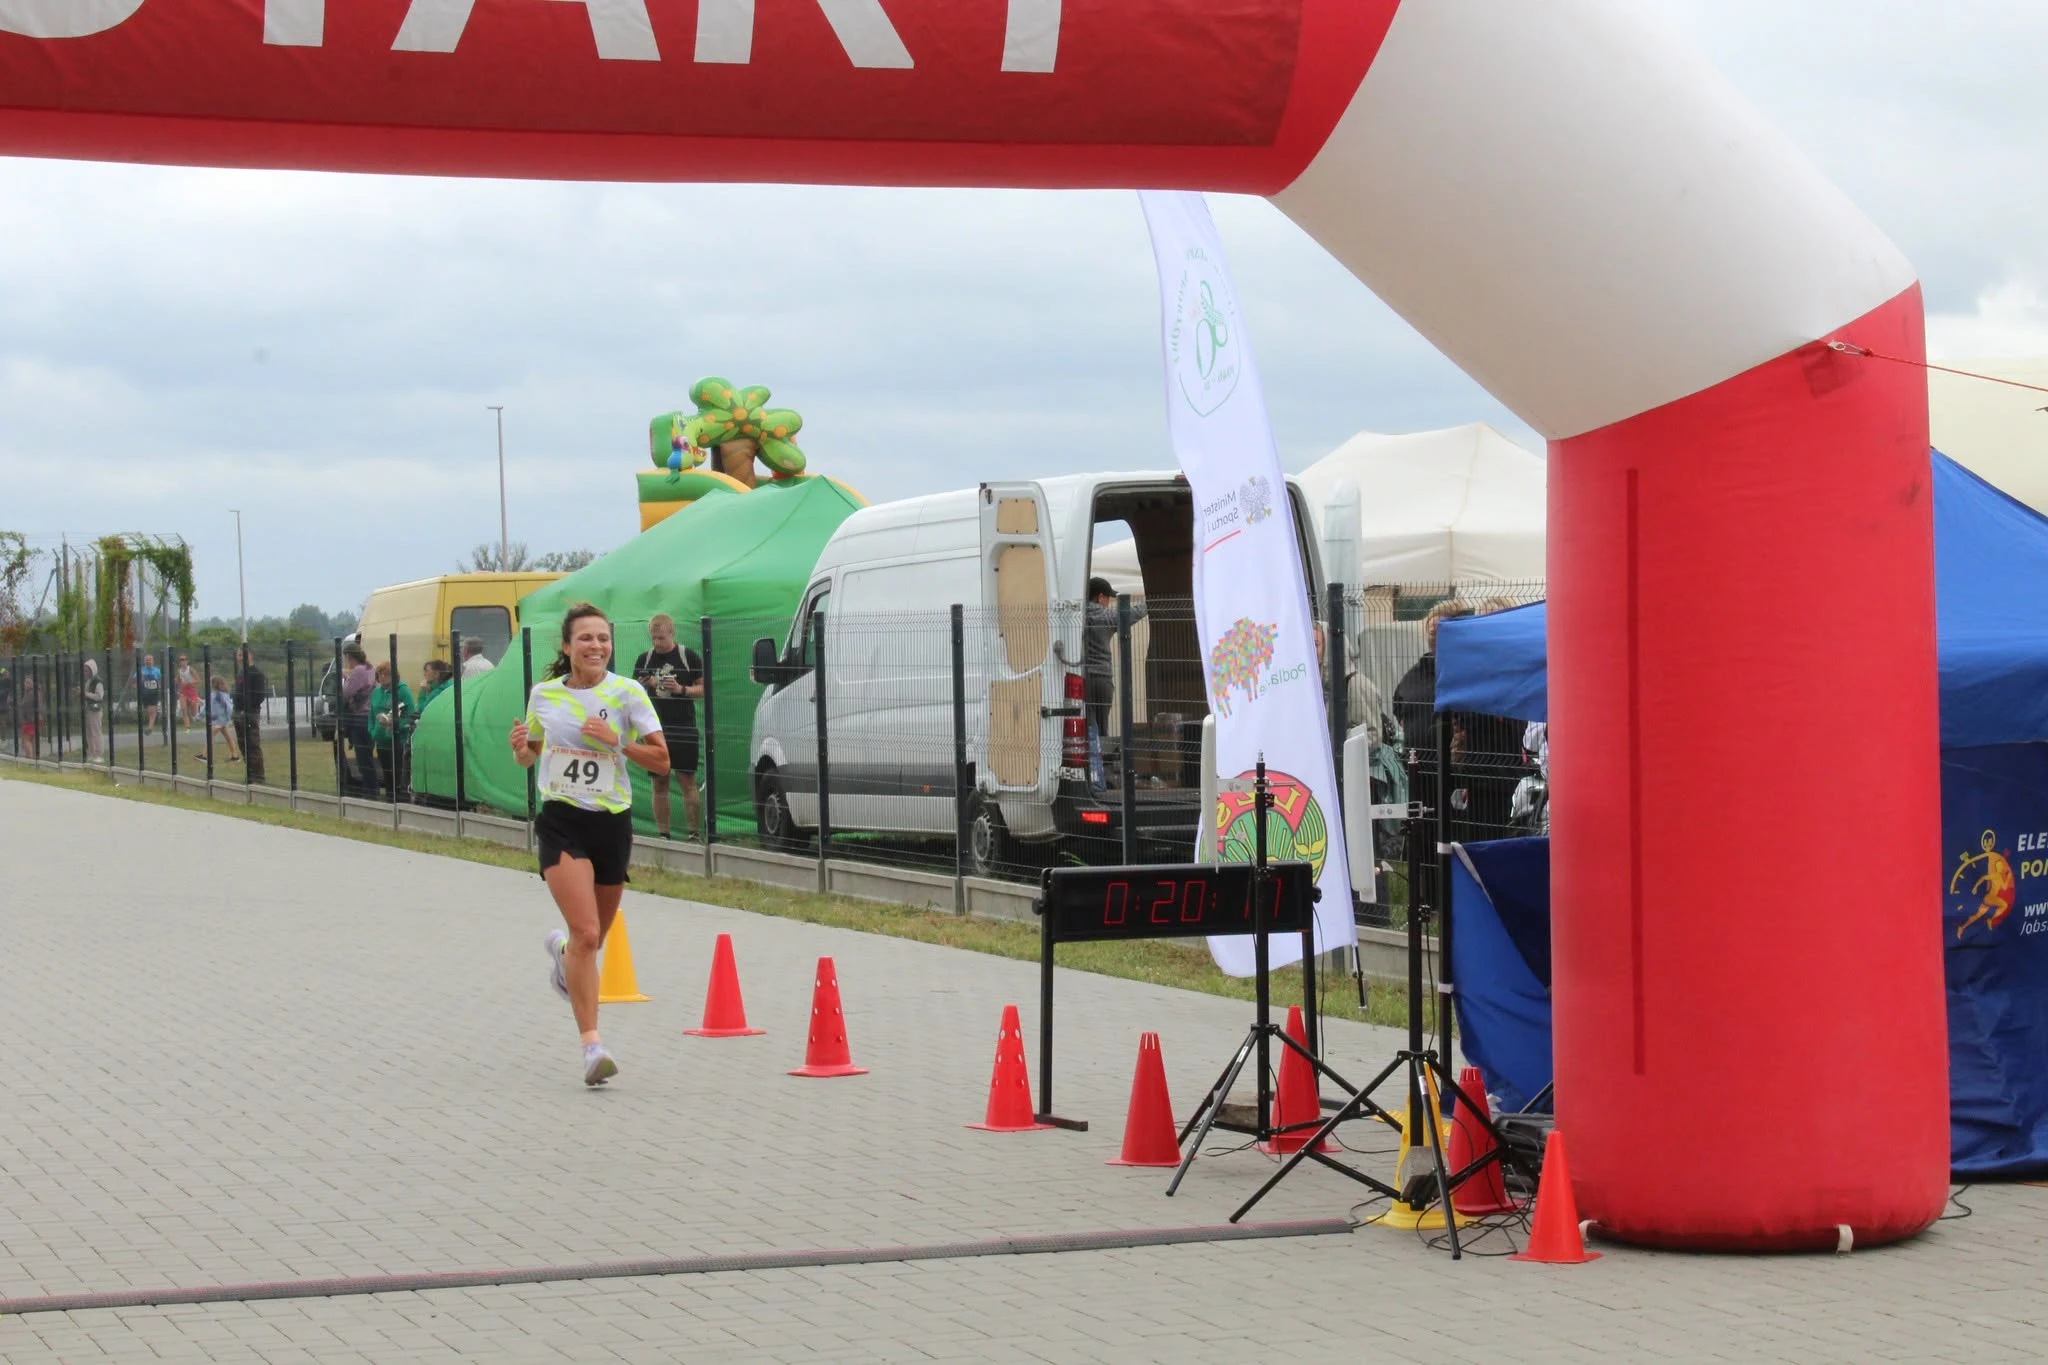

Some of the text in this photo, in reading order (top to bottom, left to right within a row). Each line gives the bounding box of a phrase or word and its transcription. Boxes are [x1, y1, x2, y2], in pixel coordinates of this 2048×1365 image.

[563, 759, 600, 785] 49
[2017, 831, 2048, 852] ELE
[2024, 902, 2048, 918] ww
